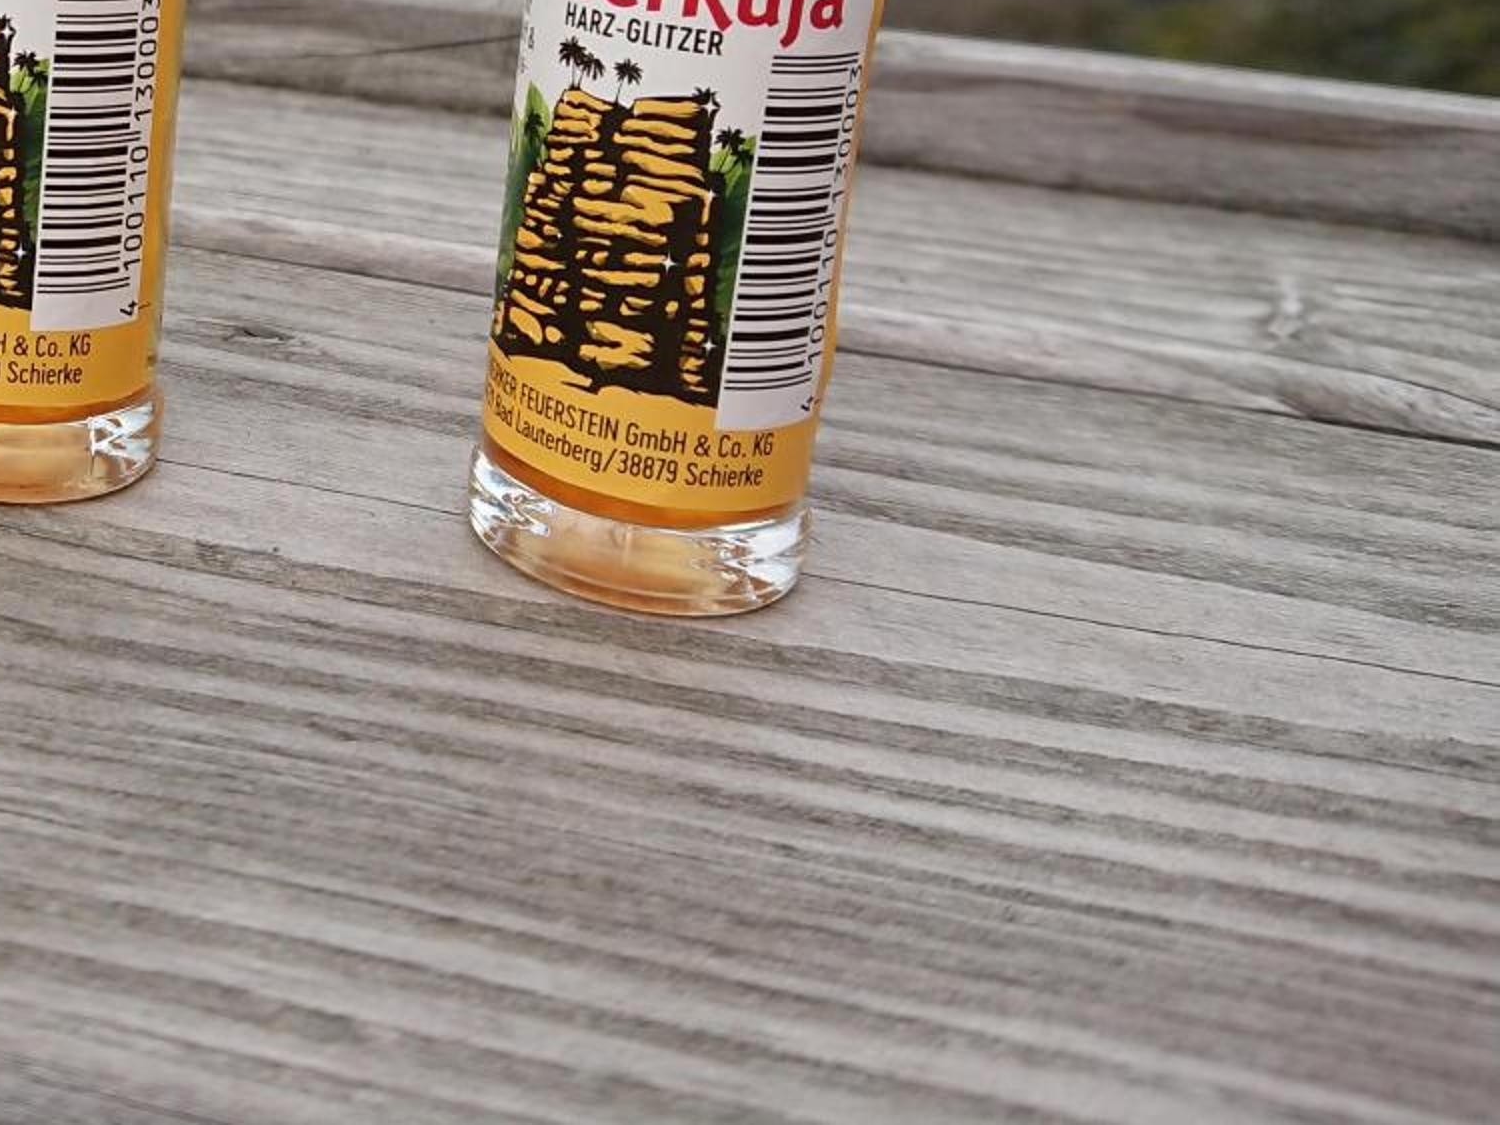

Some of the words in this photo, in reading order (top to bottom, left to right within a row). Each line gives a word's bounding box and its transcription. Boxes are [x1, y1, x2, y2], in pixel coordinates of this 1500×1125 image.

[564, 1, 725, 56] HARZ-GLITZER
[7, 361, 83, 385] Schierke
[13, 335, 29, 357] &
[35, 335, 64, 358] Co.
[69, 334, 91, 356] KG
[520, 382, 620, 443] FEUERSTEIN
[625, 421, 687, 458] GmbH
[693, 435, 711, 458] &
[718, 434, 747, 458] Co.
[752, 432, 774, 457] KG
[515, 408, 679, 485] Lauterberg/38879
[684, 462, 764, 489] Schierke
